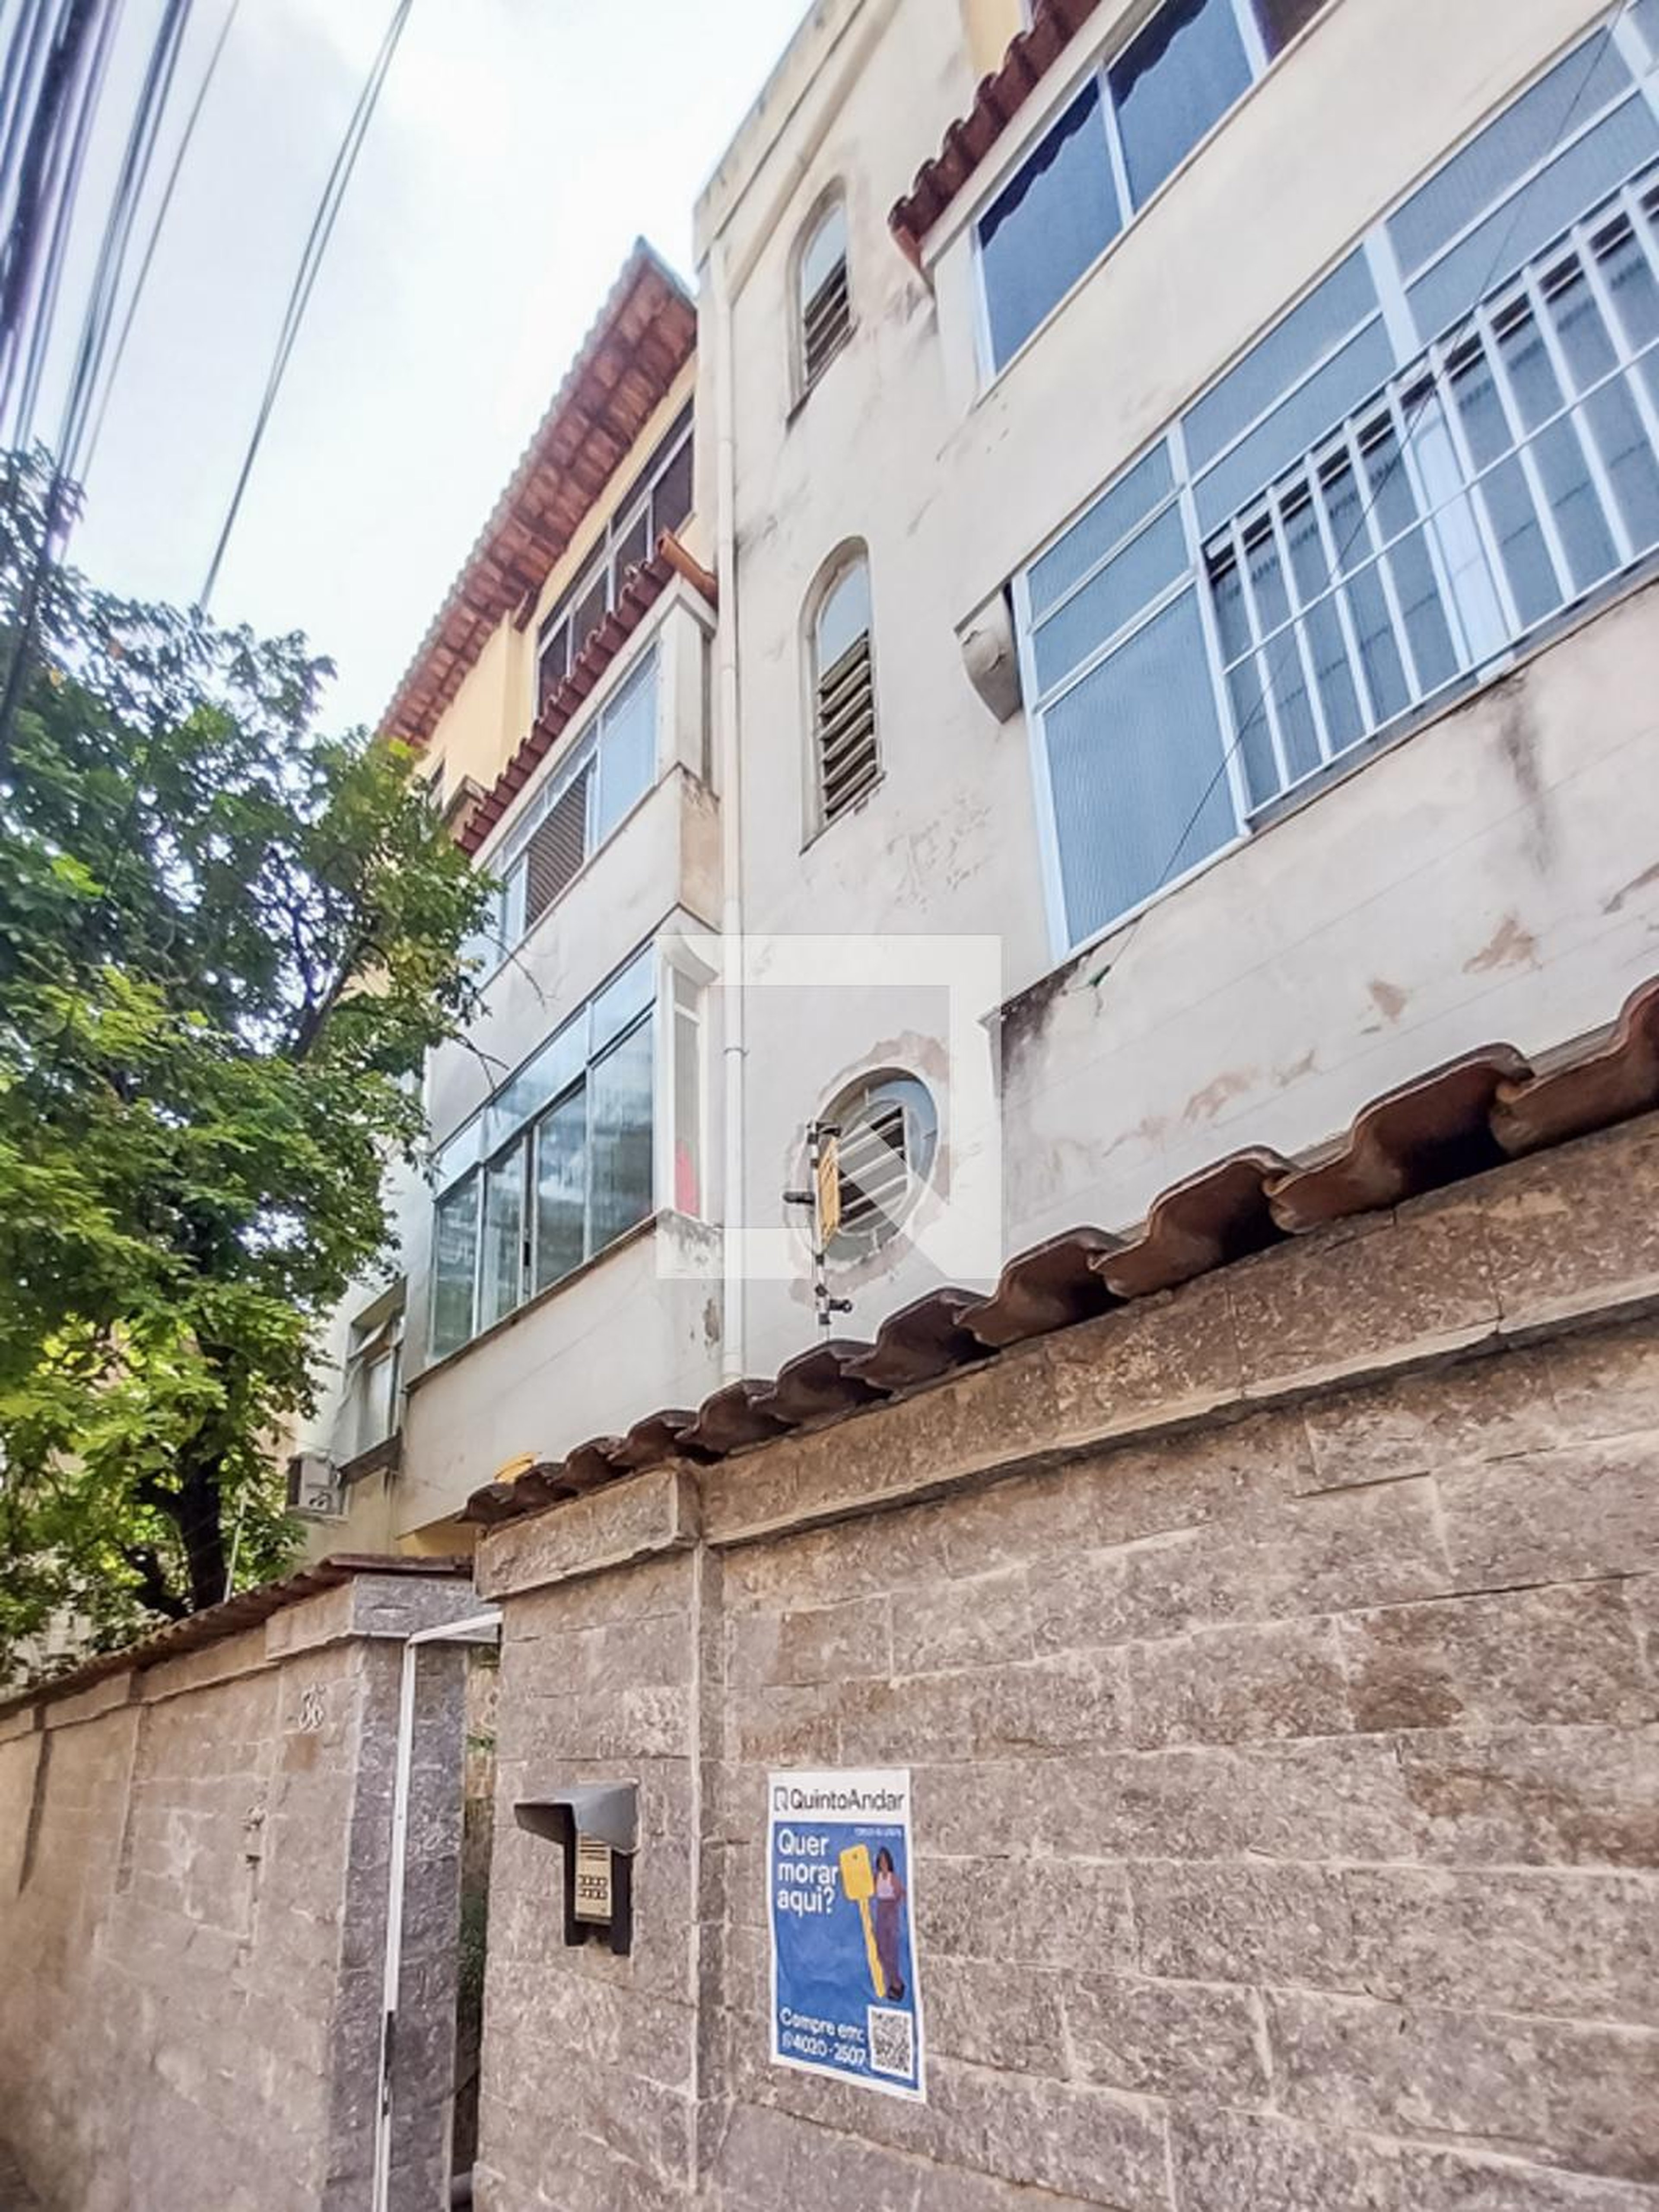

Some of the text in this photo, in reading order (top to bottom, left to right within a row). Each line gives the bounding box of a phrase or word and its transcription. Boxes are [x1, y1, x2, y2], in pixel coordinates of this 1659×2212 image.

[790, 1788, 904, 1811] QuintoAndar
[778, 1829, 830, 1856] Quer
[778, 1862, 839, 1885] morar
[777, 1886, 835, 1918] aqui?
[779, 2007, 835, 2037] Compre
